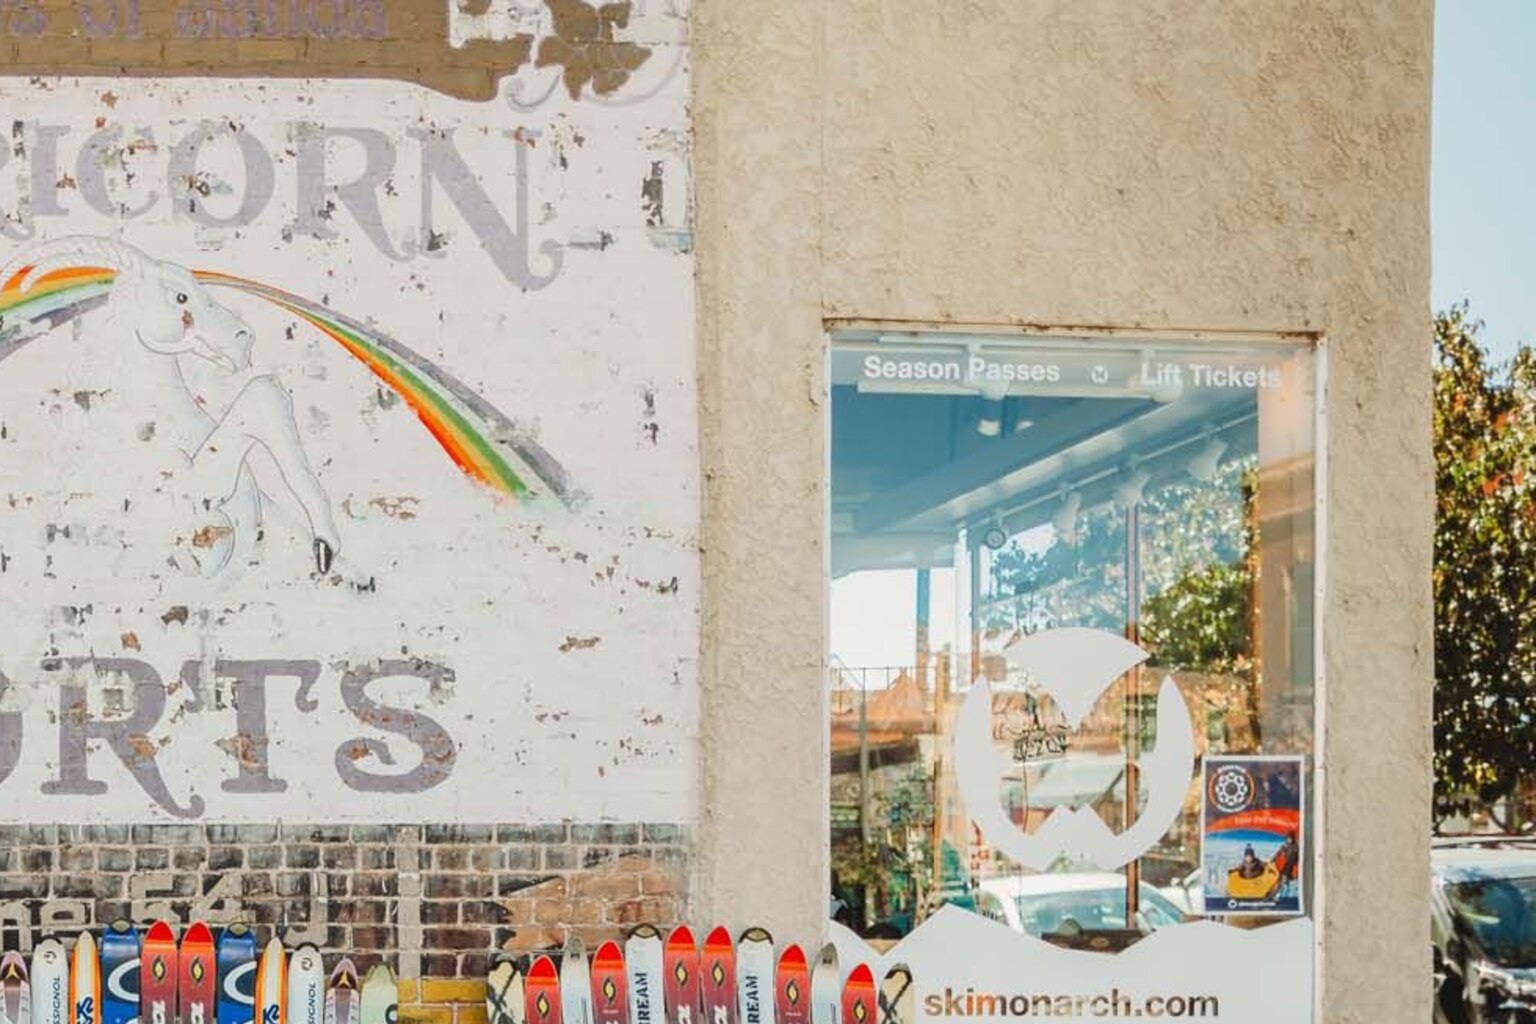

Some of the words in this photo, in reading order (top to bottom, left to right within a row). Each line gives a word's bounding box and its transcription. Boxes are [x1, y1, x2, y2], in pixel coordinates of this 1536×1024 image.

[863, 356, 960, 381] Season
[969, 359, 1061, 384] Passes
[1141, 361, 1183, 387] Lift
[1190, 364, 1283, 389] Tickets
[924, 988, 1219, 1017] skimonarch.com
